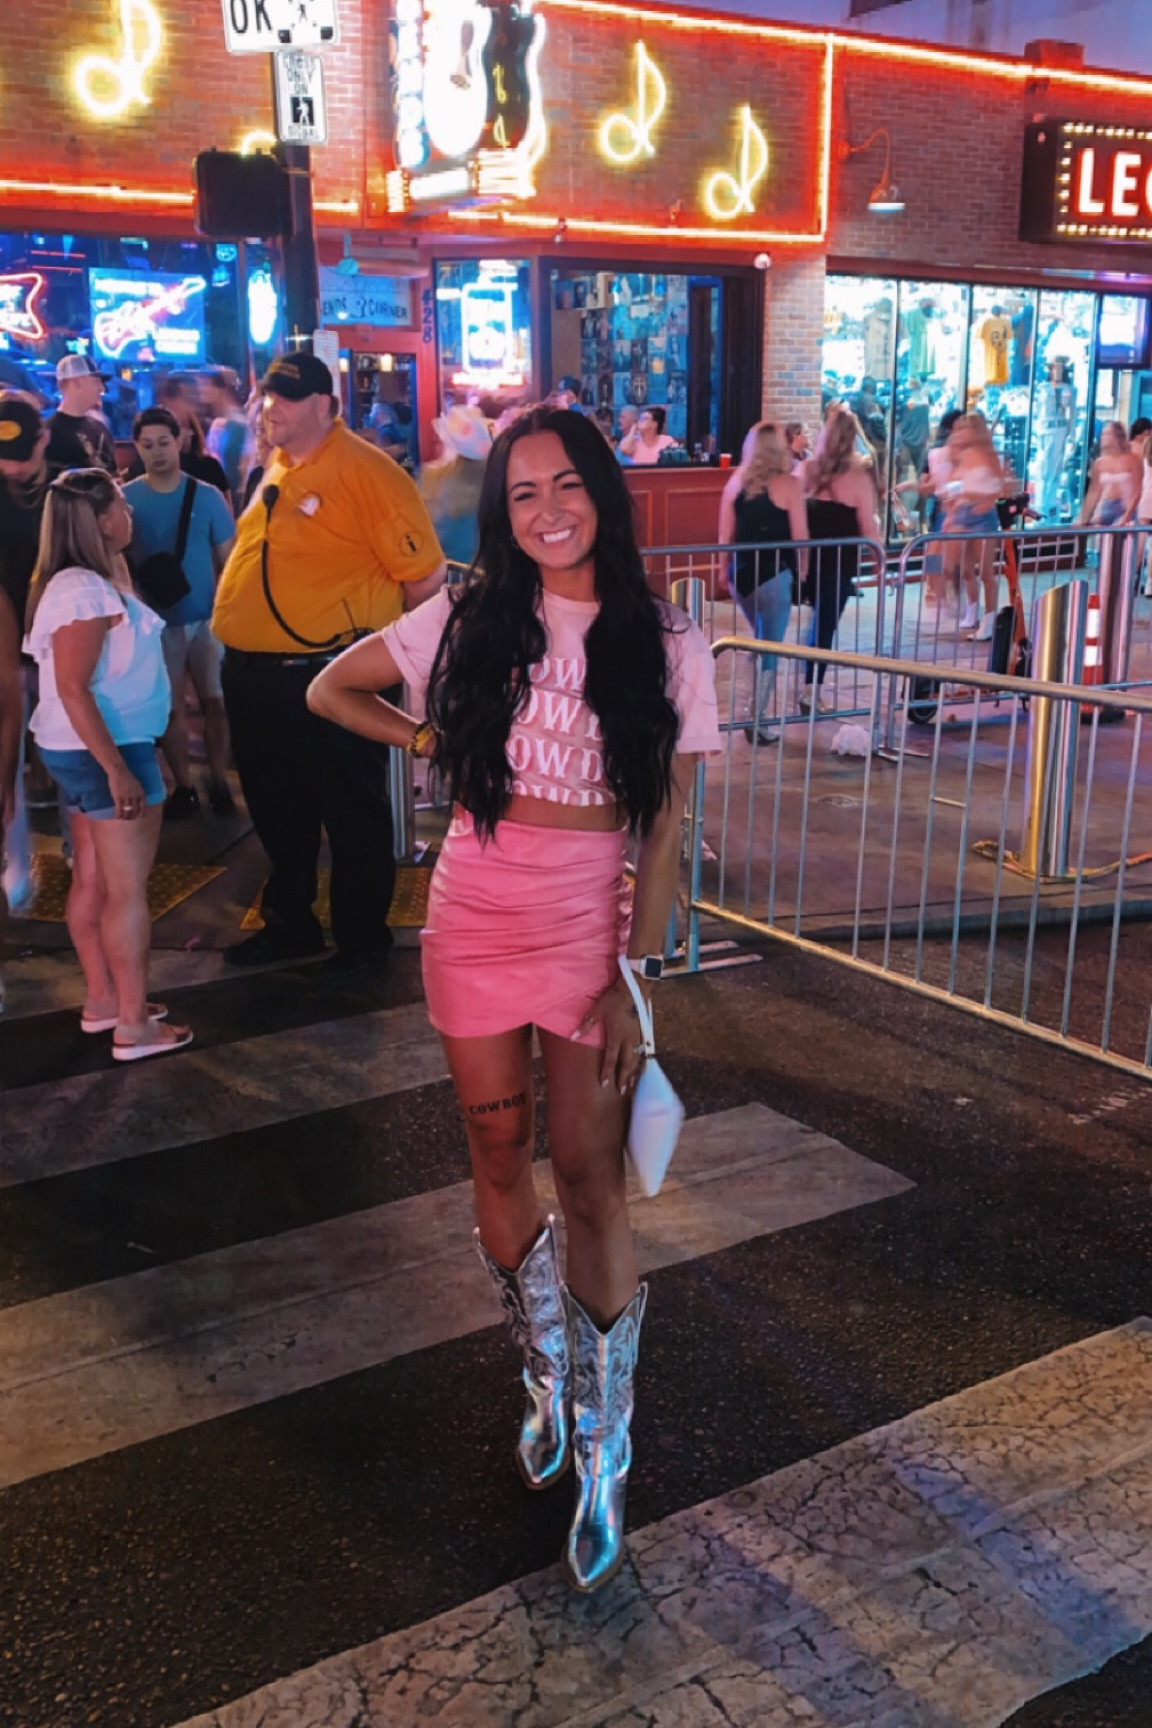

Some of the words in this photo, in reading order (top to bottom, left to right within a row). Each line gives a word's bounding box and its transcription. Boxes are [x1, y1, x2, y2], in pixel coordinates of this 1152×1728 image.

[230, 0, 272, 33] OK
[1078, 147, 1152, 217] LE
[506, 734, 604, 783] OWD
[469, 1092, 526, 1116] COWBOY
